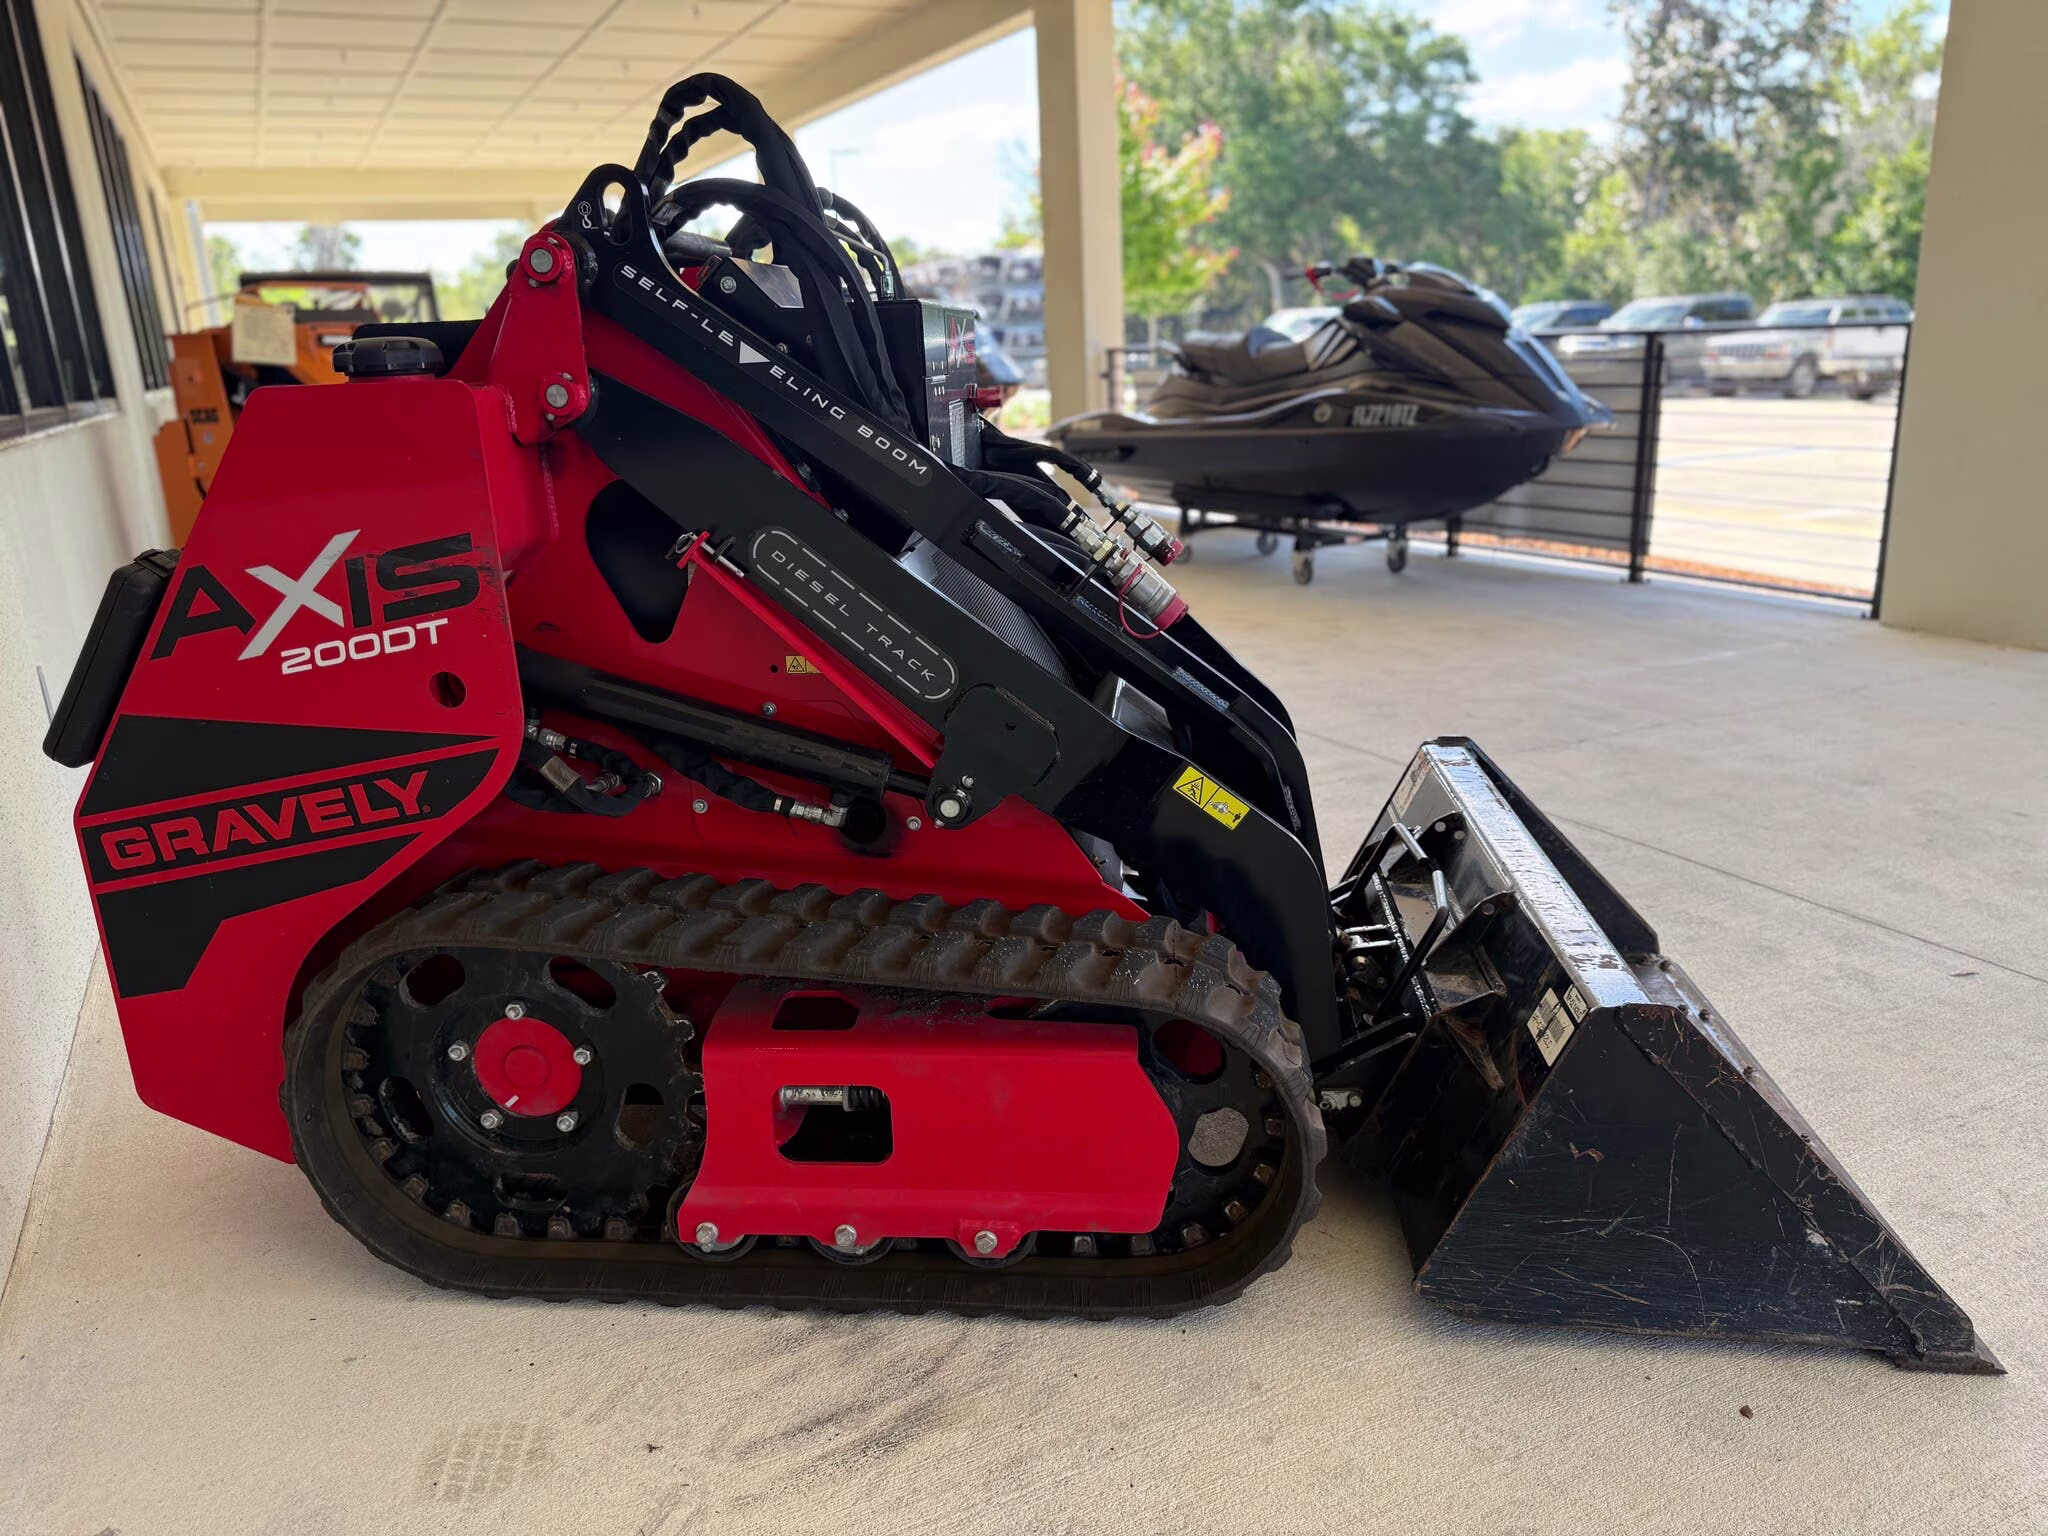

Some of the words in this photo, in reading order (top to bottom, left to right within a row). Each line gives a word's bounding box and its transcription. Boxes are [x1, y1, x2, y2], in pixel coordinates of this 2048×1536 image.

[857, 425, 928, 475] BOOM
[149, 529, 480, 661] AXIS
[771, 551, 849, 616] DIESEL
[866, 623, 936, 681] TRACK
[281, 618, 448, 674] 200DT
[101, 771, 430, 870] GRAVELY
